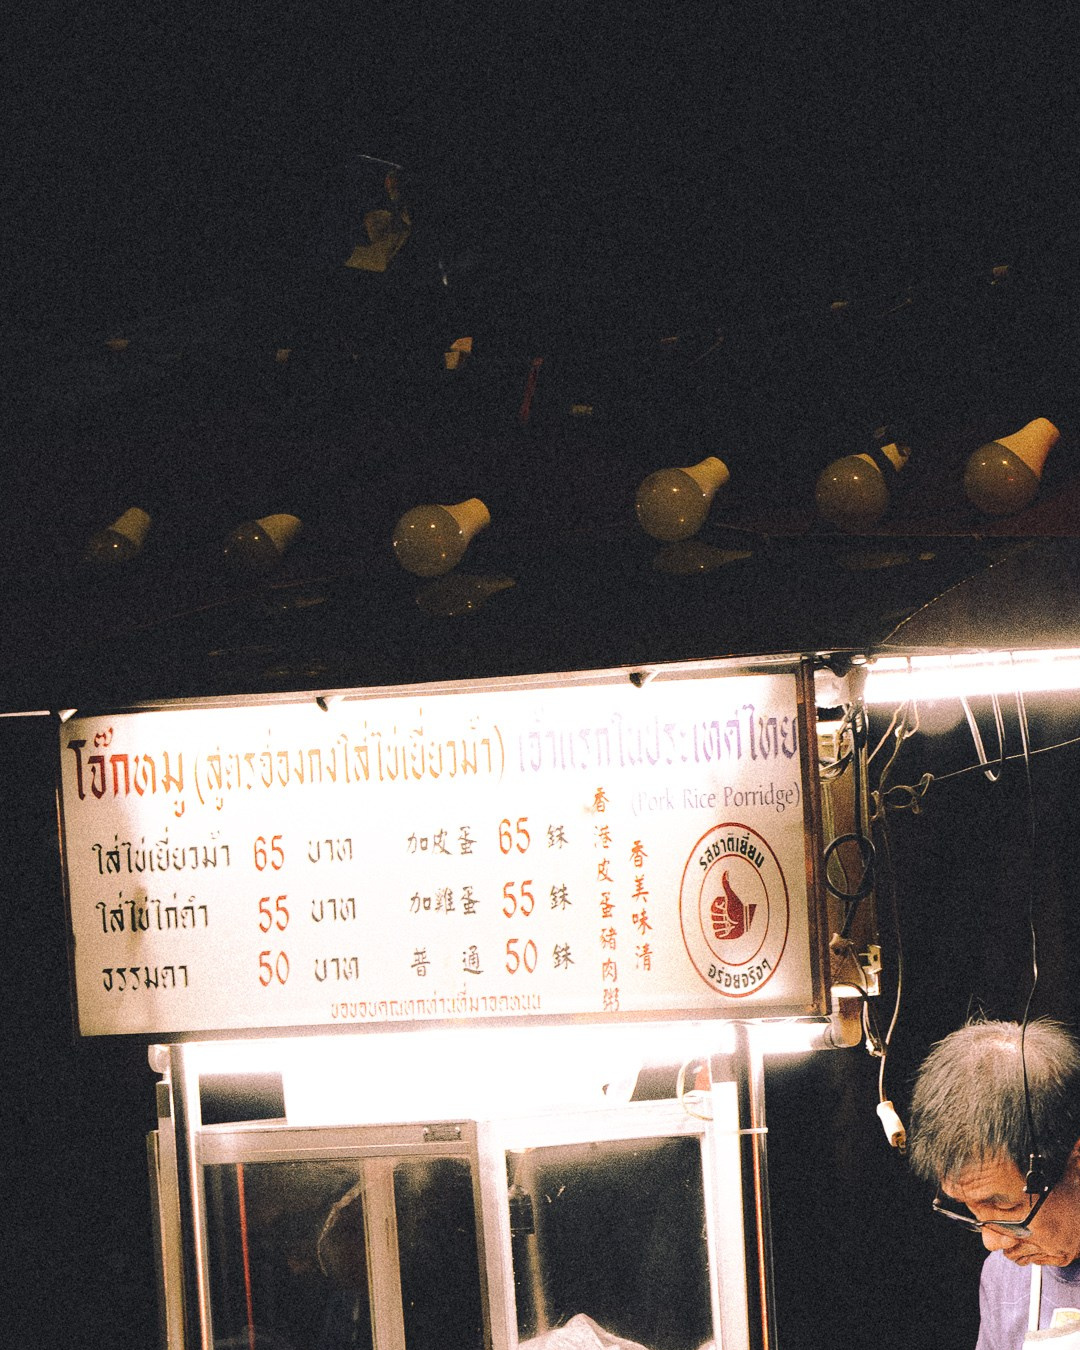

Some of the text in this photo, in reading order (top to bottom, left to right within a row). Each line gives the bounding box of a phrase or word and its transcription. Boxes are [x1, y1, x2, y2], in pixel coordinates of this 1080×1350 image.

[67, 726, 185, 817] โจ๊กหมู
[683, 788, 716, 809] Rice
[723, 782, 801, 813] Porridge)
[254, 834, 285, 871] 65
[308, 838, 353, 863] บาท
[406, 826, 477, 856] 加皮蛋
[498, 816, 531, 855] 65
[699, 832, 765, 871] รสชาติเยี่ยม
[258, 895, 290, 933] 55
[311, 897, 356, 923] บาท
[502, 880, 536, 918] 55
[102, 950, 360, 992] ธรรมดา 50 บาท
[505, 938, 538, 976] 50
